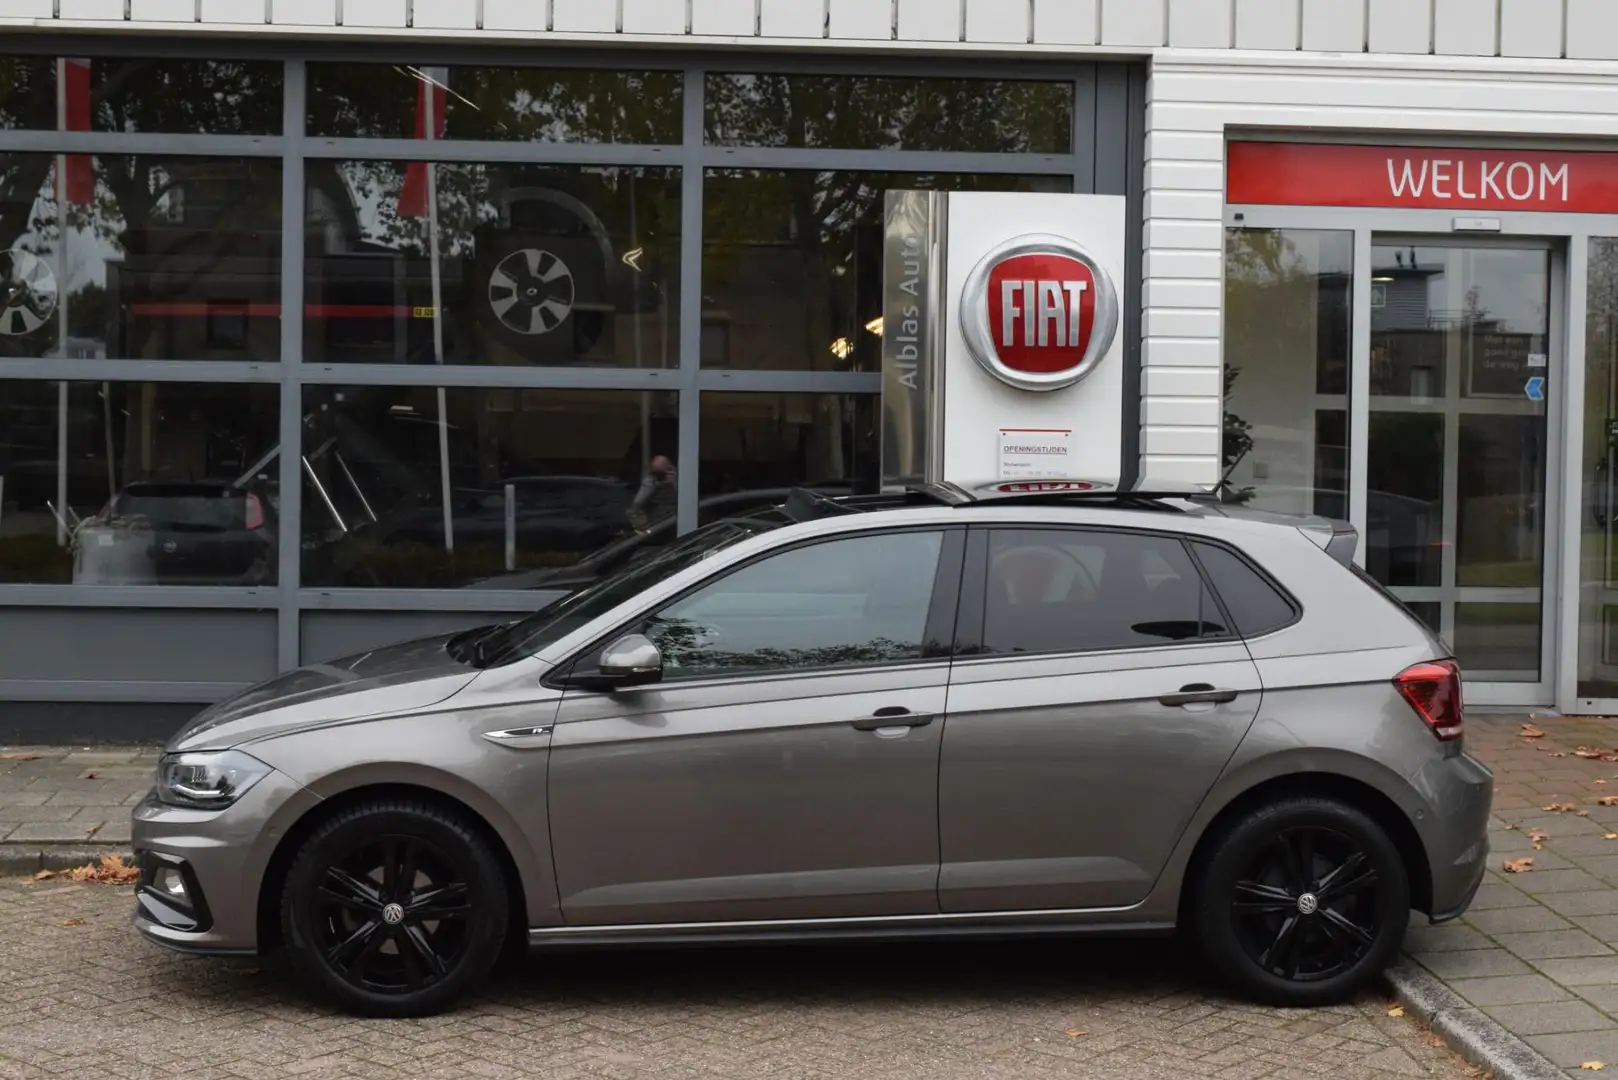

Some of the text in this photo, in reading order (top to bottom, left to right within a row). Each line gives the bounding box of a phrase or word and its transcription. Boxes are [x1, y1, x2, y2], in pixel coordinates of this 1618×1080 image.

[1387, 158, 1569, 202] WELKOM
[895, 235, 921, 390] Alblas Auto
[1002, 280, 1087, 348] FIAT
